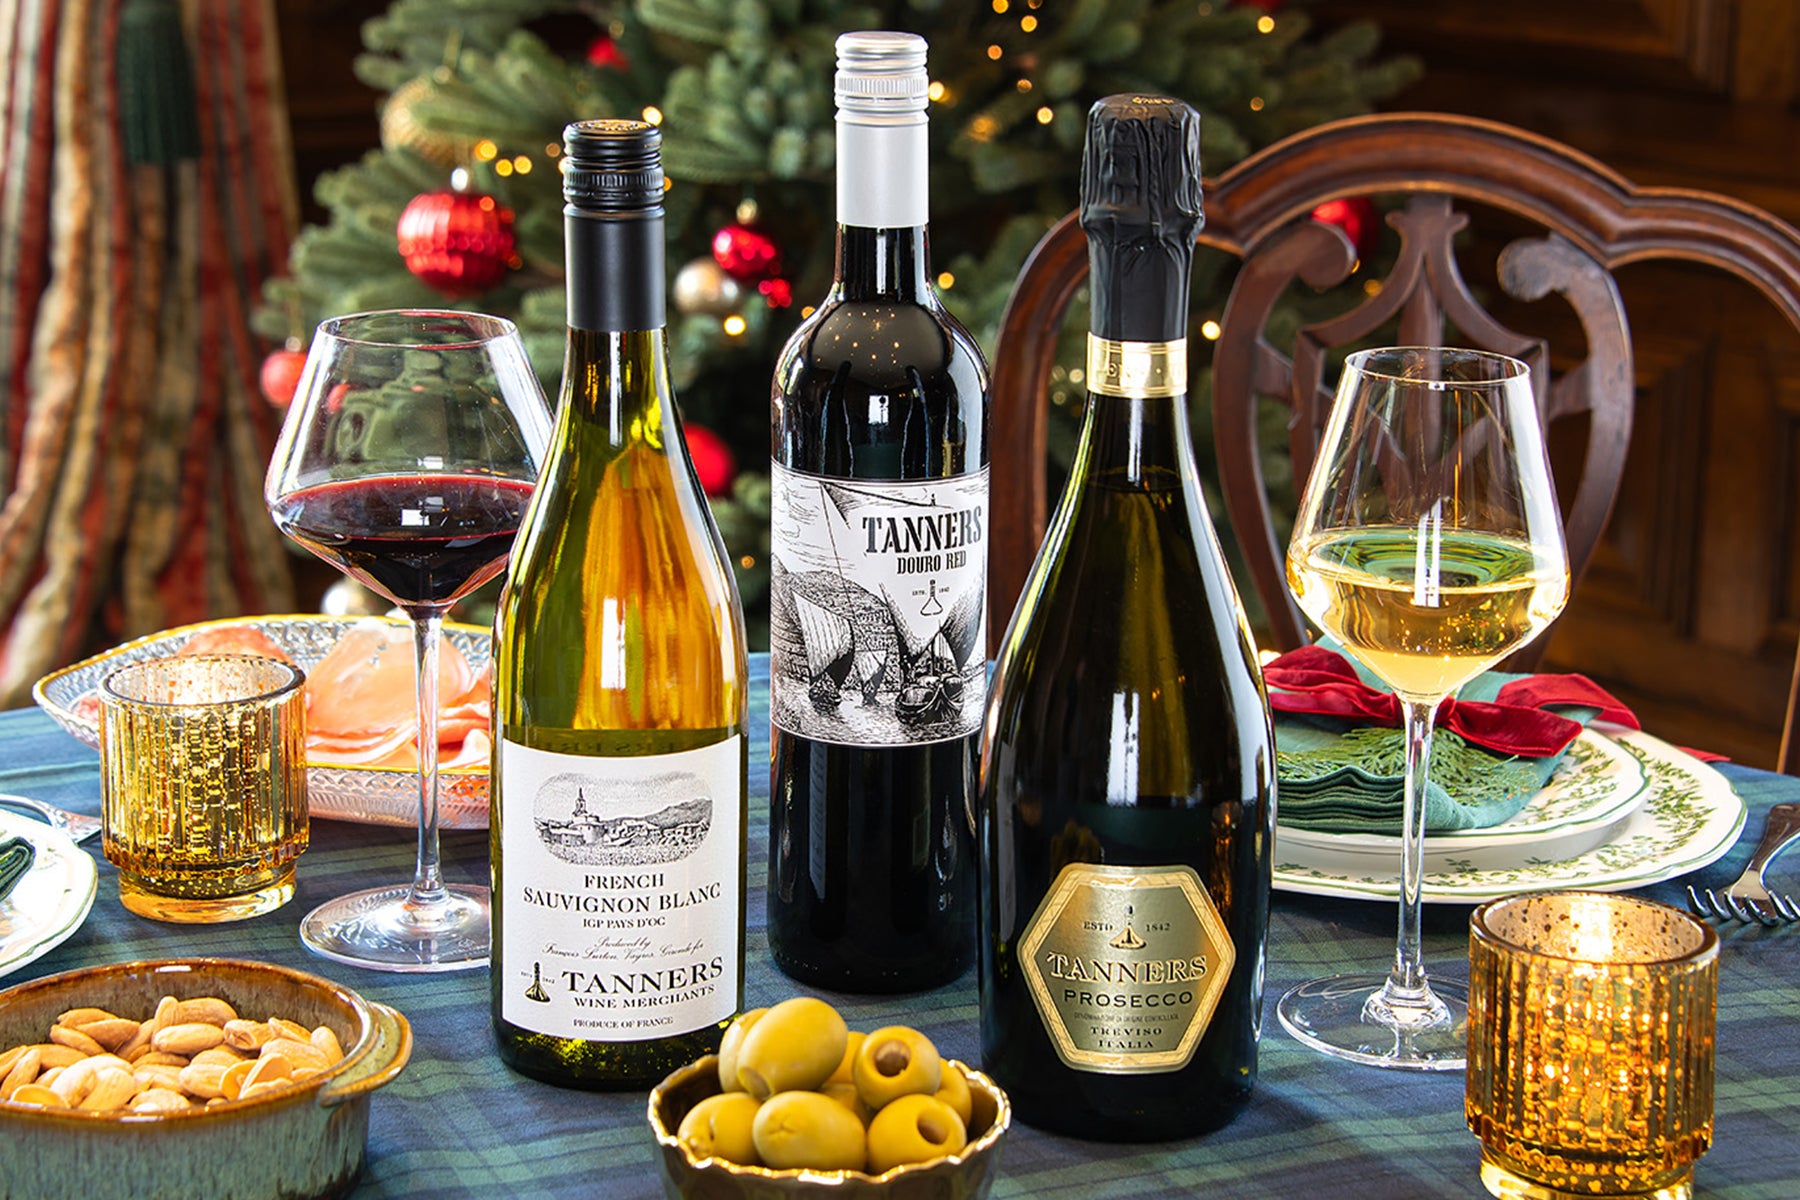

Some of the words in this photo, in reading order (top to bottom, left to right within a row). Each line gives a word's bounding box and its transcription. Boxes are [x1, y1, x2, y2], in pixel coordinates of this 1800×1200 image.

[862, 505, 982, 553] TANNERS
[897, 554, 941, 575] DOURO
[946, 550, 967, 570] RED
[584, 873, 665, 890] FRENCH
[523, 886, 651, 914] SAUVIGNON
[659, 882, 721, 911] BLANC
[583, 918, 604, 929] IGP
[607, 919, 634, 929] PAYS
[637, 916, 666, 928] D'OC
[1083, 920, 1114, 932] ESTD
[1145, 921, 1171, 932] 1842
[594, 936, 639, 948] Produced
[639, 936, 652, 951] by
[561, 956, 724, 994] TANNERS
[1046, 951, 1207, 985] TANNERS
[573, 996, 617, 1009] WINE
[623, 984, 716, 1009] MERCHANTS
[1064, 989, 1194, 1008] PROSECCO
[573, 1018, 619, 1028] PRODUCE
[621, 1019, 635, 1028] OF
[636, 1016, 674, 1028] FRANCE
[1091, 1026, 1163, 1036] TREVISO
[1099, 1040, 1154, 1048] ITALIA
